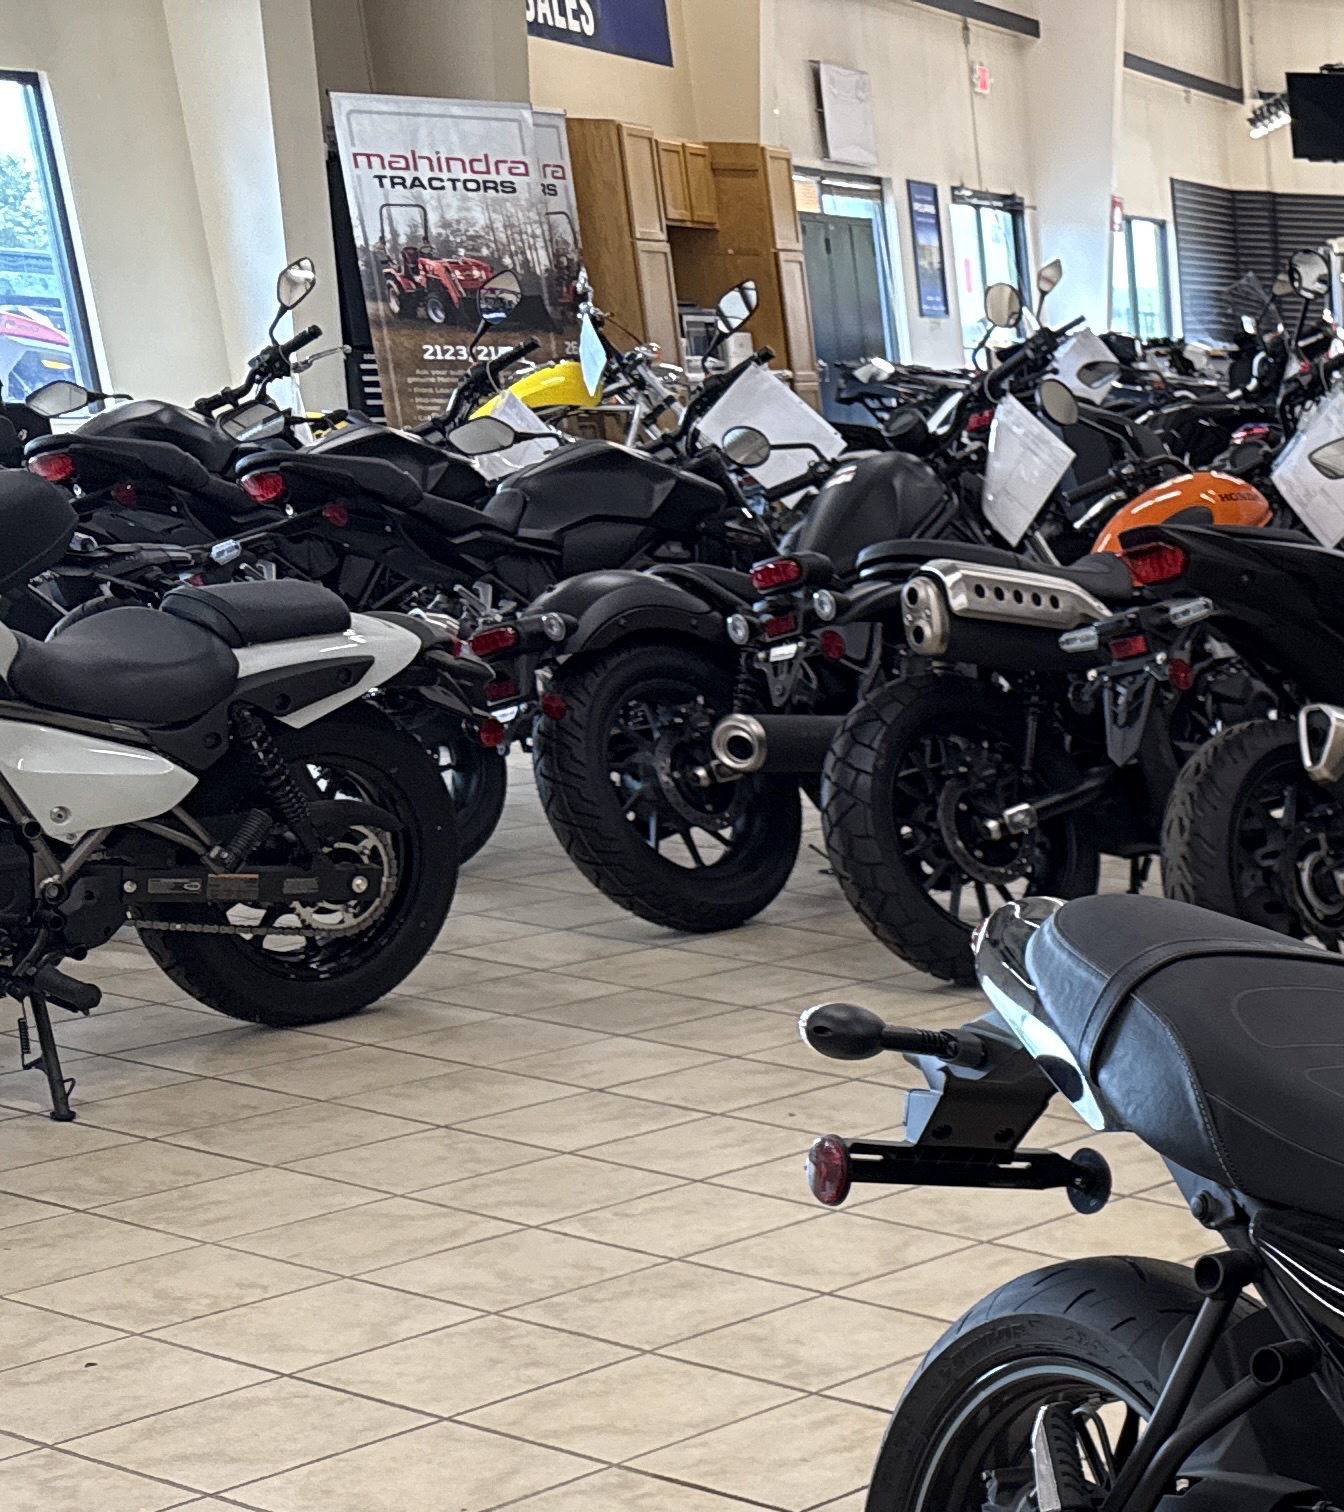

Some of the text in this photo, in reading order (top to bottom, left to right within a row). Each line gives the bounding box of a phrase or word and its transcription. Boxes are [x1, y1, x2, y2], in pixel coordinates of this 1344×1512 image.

[526, 0, 595, 36] ALES
[352, 150, 530, 177] mahindra
[373, 174, 517, 194] TRACTORS
